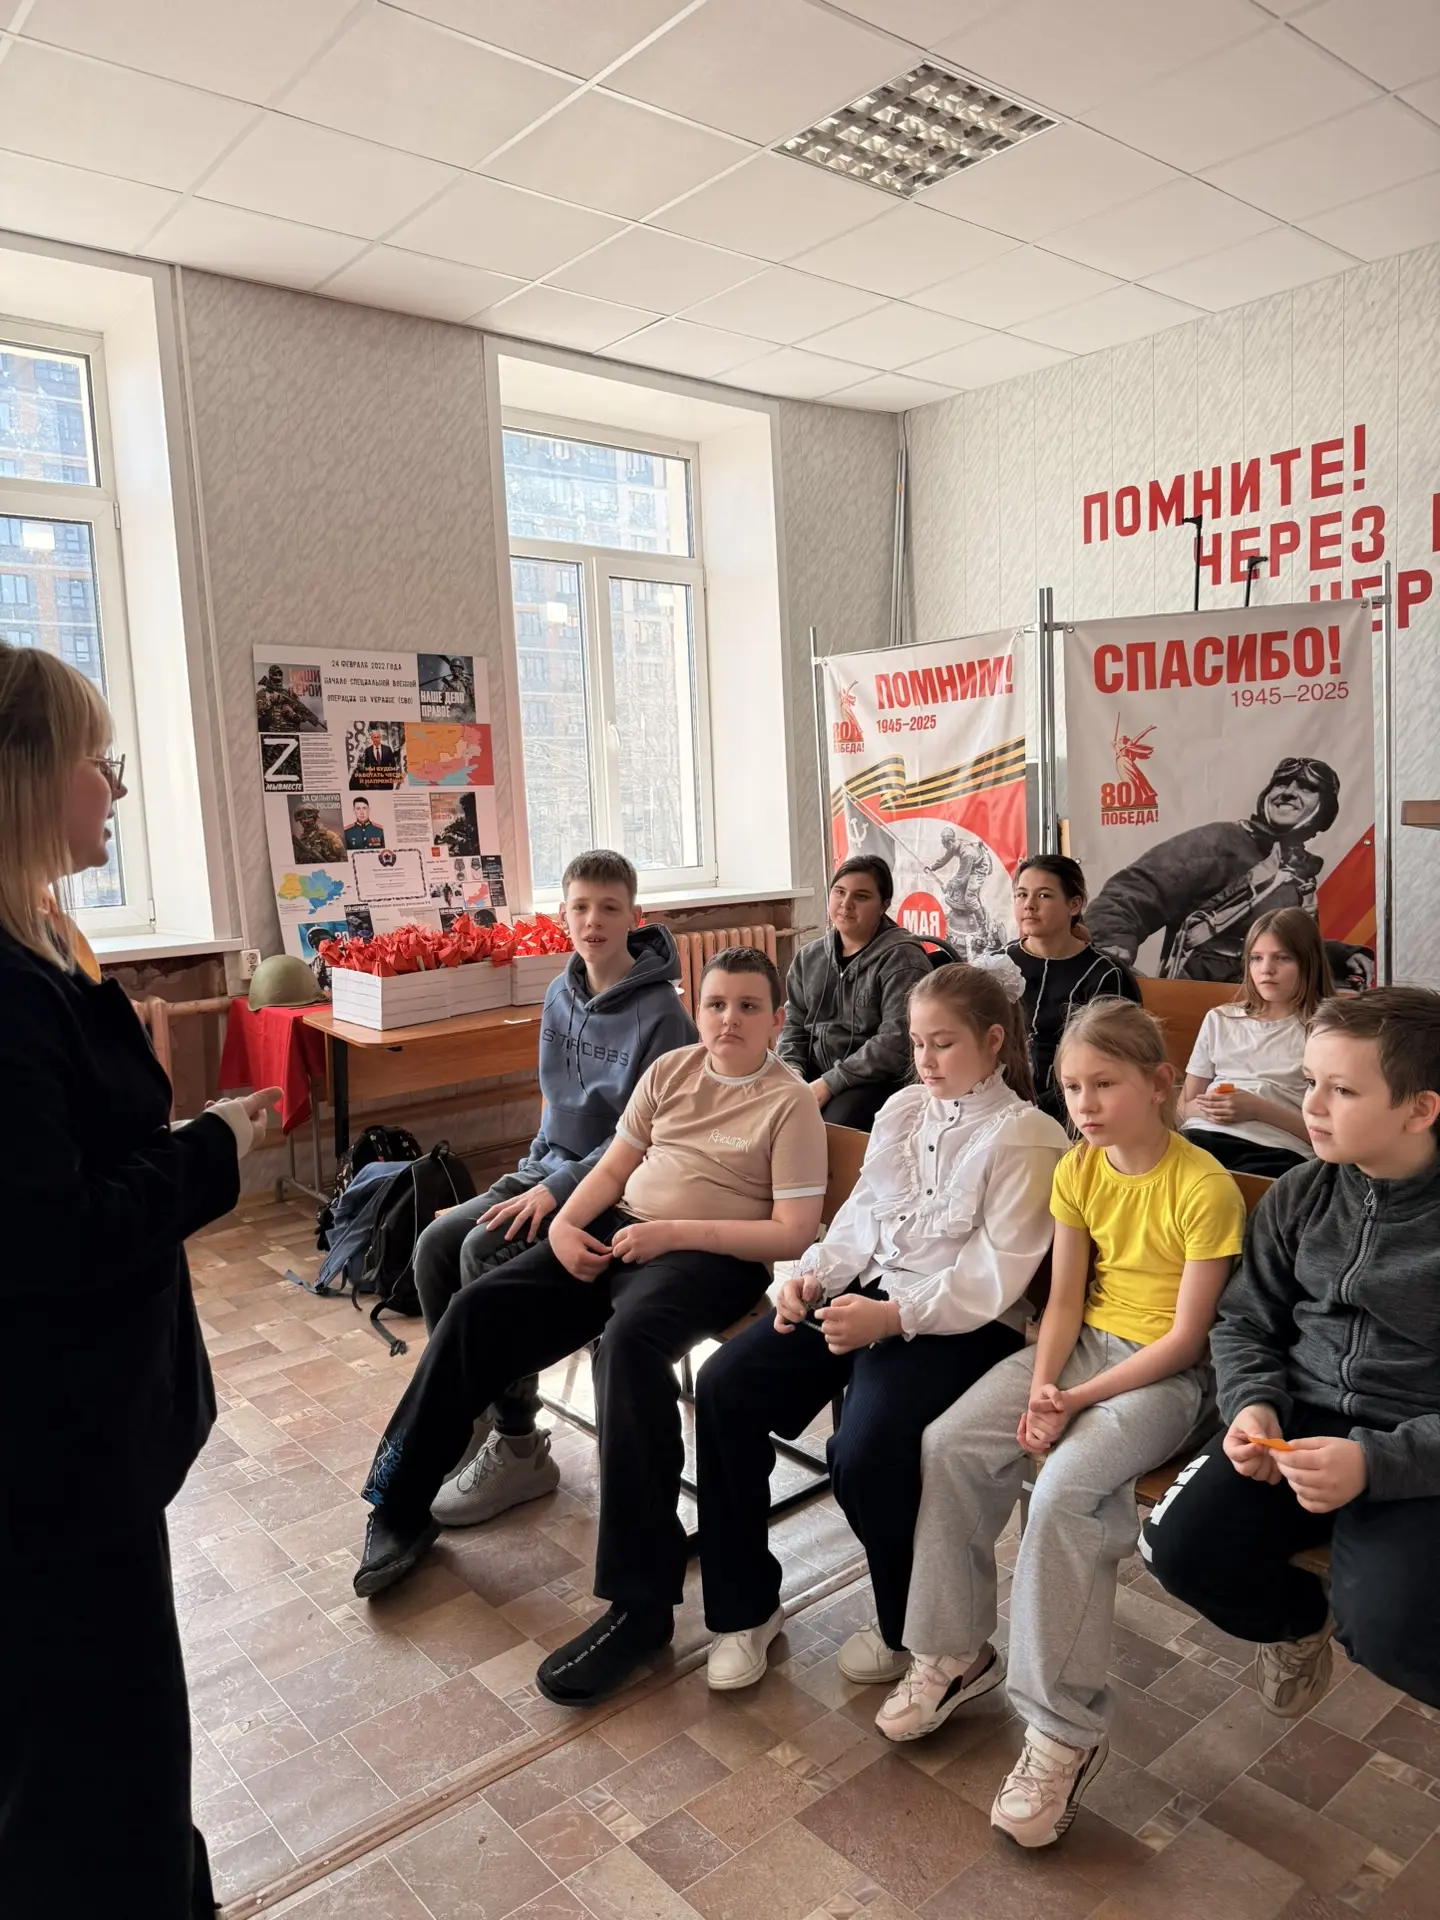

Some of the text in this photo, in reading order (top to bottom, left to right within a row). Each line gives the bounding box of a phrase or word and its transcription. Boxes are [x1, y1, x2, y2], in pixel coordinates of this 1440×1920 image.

[1083, 423, 1366, 545] ПОМНИТЕ!
[1194, 505, 1385, 586] ЧЕРЕЗ
[331, 660, 402, 671] 24 ФЕВРАЛЯ 2022 ГОДА
[1094, 625, 1341, 694] СПАСИБО!
[324, 677, 347, 685] НАЧАЛО
[874, 654, 1014, 710] ПОМНИМ!
[420, 690, 465, 705] НАШЕ ДЕЛО
[421, 705, 451, 718] ПРАВОЕ
[1101, 782, 1132, 808] 80
[1101, 809, 1159, 826] ПОБЕДА!
[903, 909, 941, 938] МАЯ
